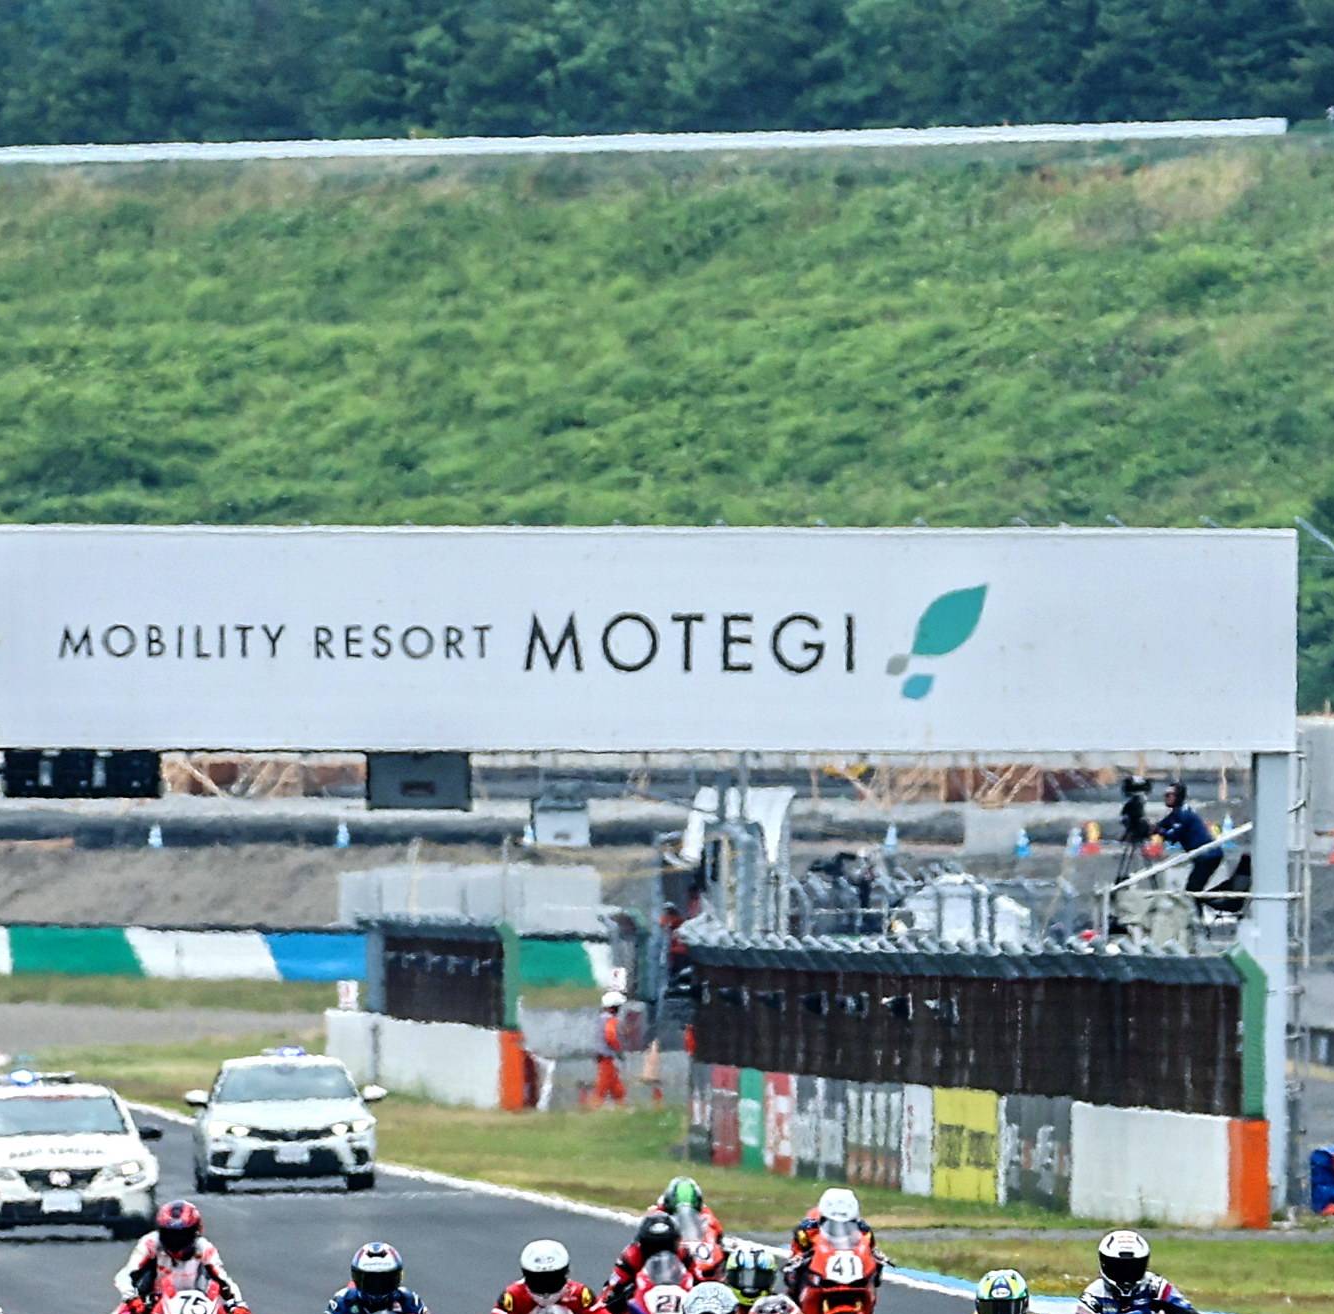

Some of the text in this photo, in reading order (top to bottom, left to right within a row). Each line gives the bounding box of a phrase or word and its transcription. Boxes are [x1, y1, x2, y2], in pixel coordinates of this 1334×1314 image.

[59, 612, 855, 673] MOBILITY RESORT MOTEGI
[832, 1257, 857, 1277] 41
